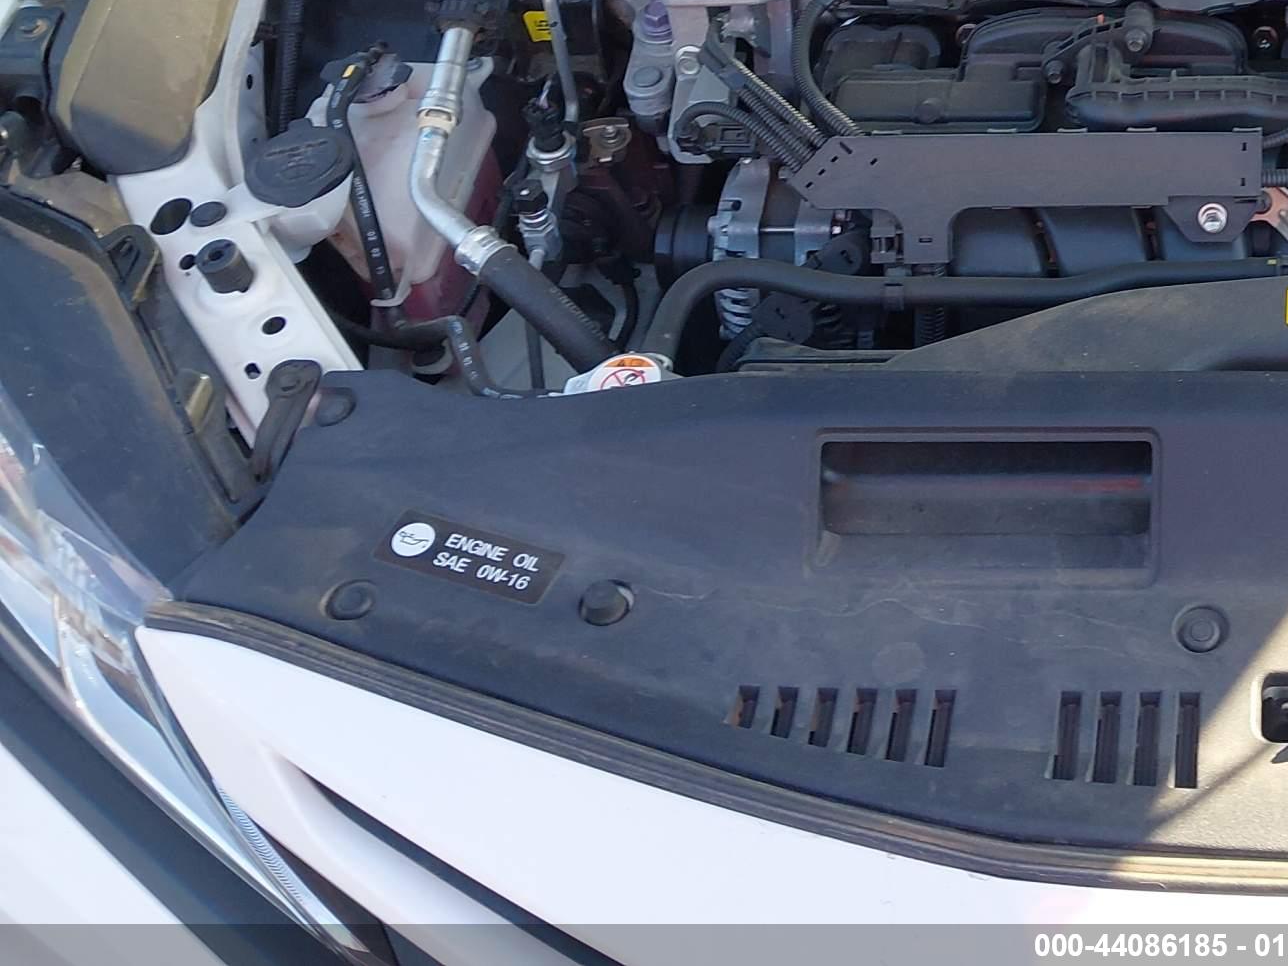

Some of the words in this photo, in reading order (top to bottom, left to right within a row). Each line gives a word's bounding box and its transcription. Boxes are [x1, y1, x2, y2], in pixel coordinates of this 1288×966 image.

[432, 552, 471, 572] SAE
[476, 564, 531, 589] 0W-16
[445, 533, 508, 561] ENGINE
[514, 553, 539, 571] OIL
